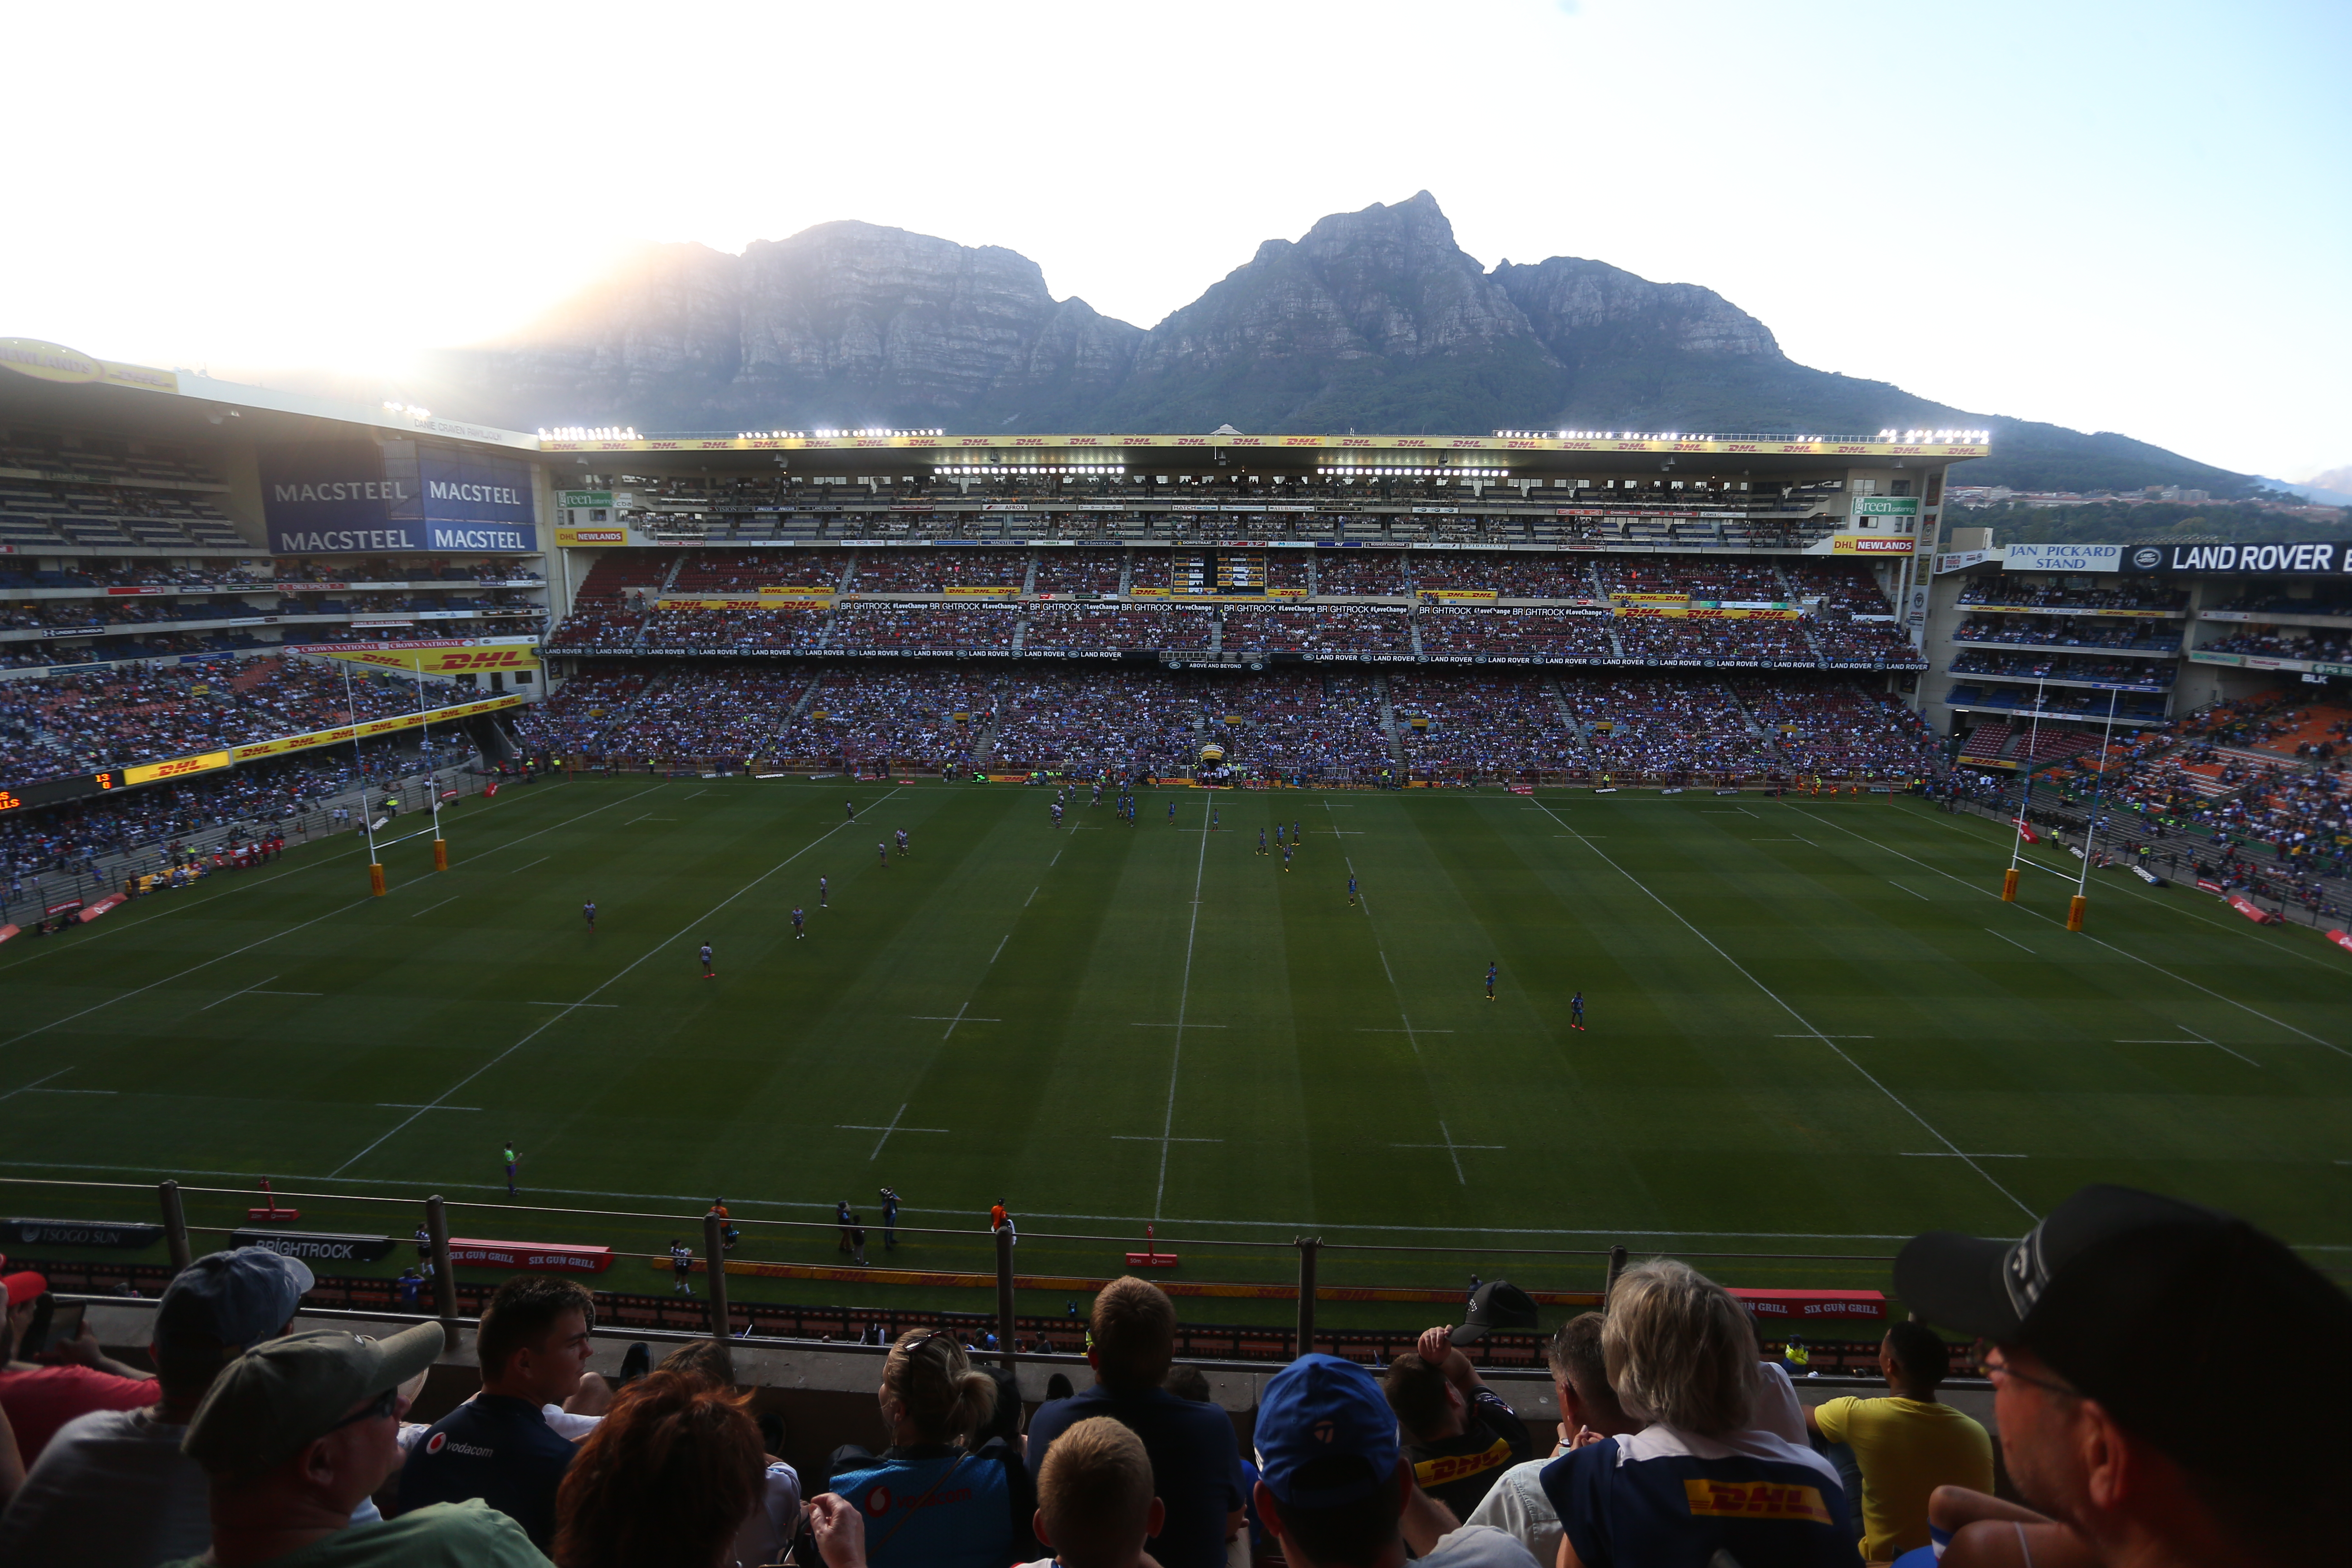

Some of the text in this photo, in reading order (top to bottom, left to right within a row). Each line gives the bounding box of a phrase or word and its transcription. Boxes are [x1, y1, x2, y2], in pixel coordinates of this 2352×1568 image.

[438, 422, 465, 435] CRAVEN
[275, 481, 408, 502] MACSTEEL
[429, 480, 520, 505] MACSTEEL
[1855, 498, 1891, 514] green
[282, 529, 414, 550] MACSTEEL
[435, 529, 525, 549] MACSTEEL
[1834, 540, 1912, 550] DHL NEWLANDS
[2009, 546, 2117, 557] JAN PICKARD
[2172, 546, 2236, 569] LAND
[2239, 544, 2333, 570] ROVER
[2036, 558, 2086, 569] STAND
[1748, 611, 1785, 619] DHL
[335, 643, 377, 652] NATIONAL
[361, 653, 401, 666] DHL
[441, 651, 522, 669] DHL
[2301, 674, 2328, 684] BLK
[289, 737, 317, 748] DHL
[242, 745, 272, 757] DHL
[158, 760, 200, 776] DHL
[96, 774, 111, 782] 13
[43, 1228, 120, 1244] TSOGO SUN
[450, 1250, 514, 1264] SIX GUN GRILL
[529, 1255, 595, 1269] SIX GUN GRILL
[756, 1266, 794, 1277] DHL
[831, 1271, 873, 1282] DHL
[921, 1275, 959, 1286] DHL
[1164, 1285, 1202, 1296] DHL
[1258, 1288, 1299, 1299] DHL
[1804, 1302, 1878, 1314] SIX GUN GRILL
[446, 1441, 494, 1457] vodacom
[1431, 1450, 1499, 1481] DHL
[897, 1488, 972, 1509] vodacom
[1708, 1485, 1813, 1514] DHL
